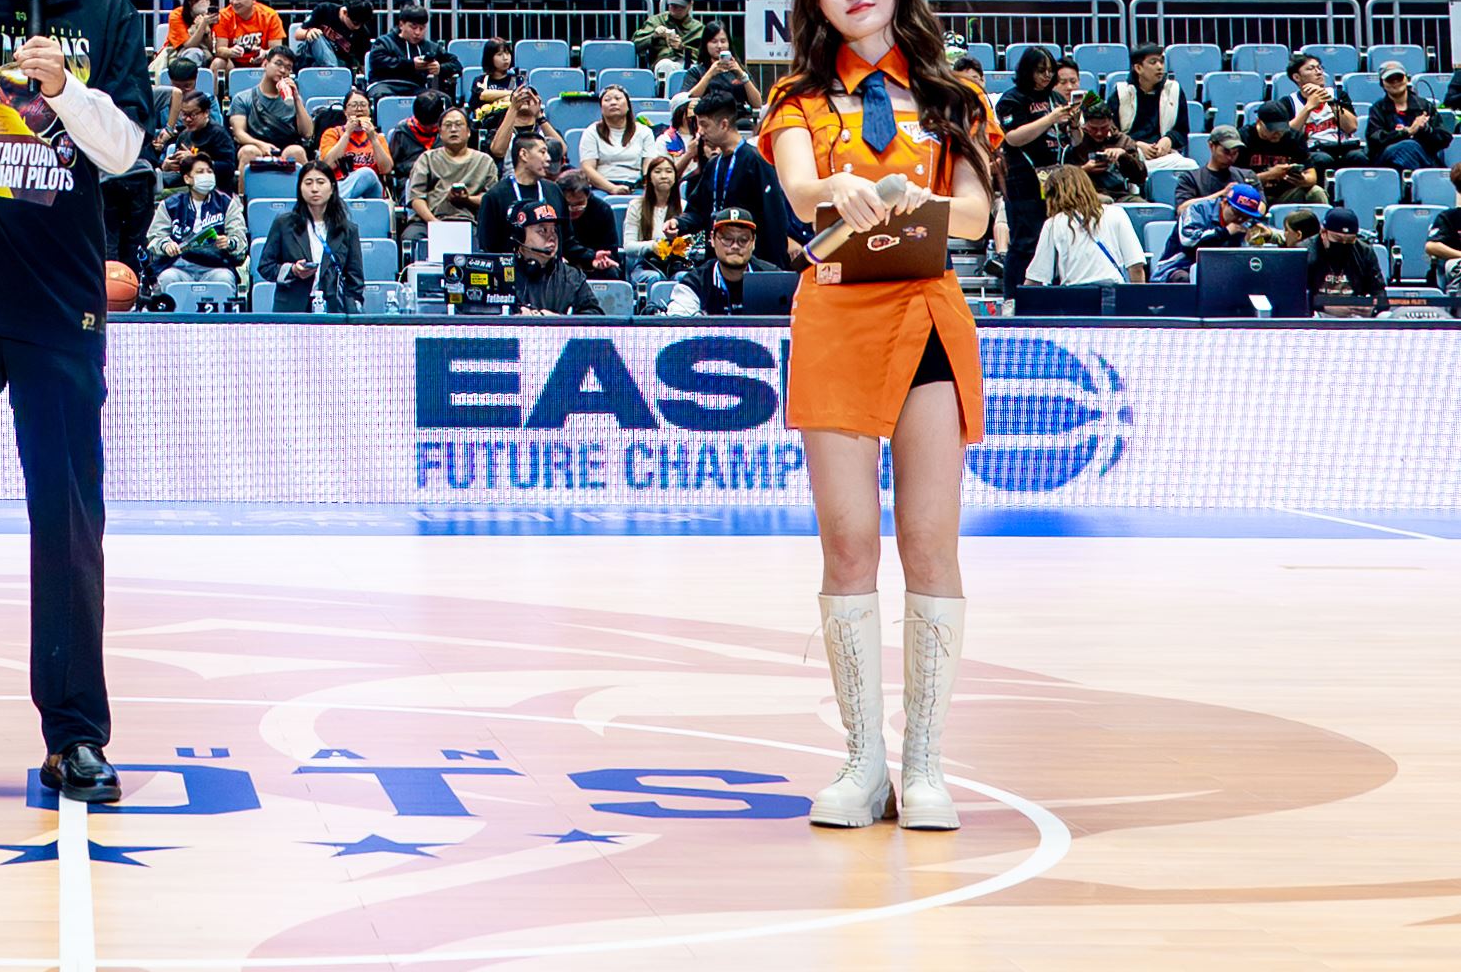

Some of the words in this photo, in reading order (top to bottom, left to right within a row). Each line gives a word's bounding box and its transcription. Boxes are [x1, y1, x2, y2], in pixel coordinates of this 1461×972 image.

[25, 166, 75, 191] PILOTS
[415, 336, 789, 432] EAS
[416, 441, 606, 489] FUTURE
